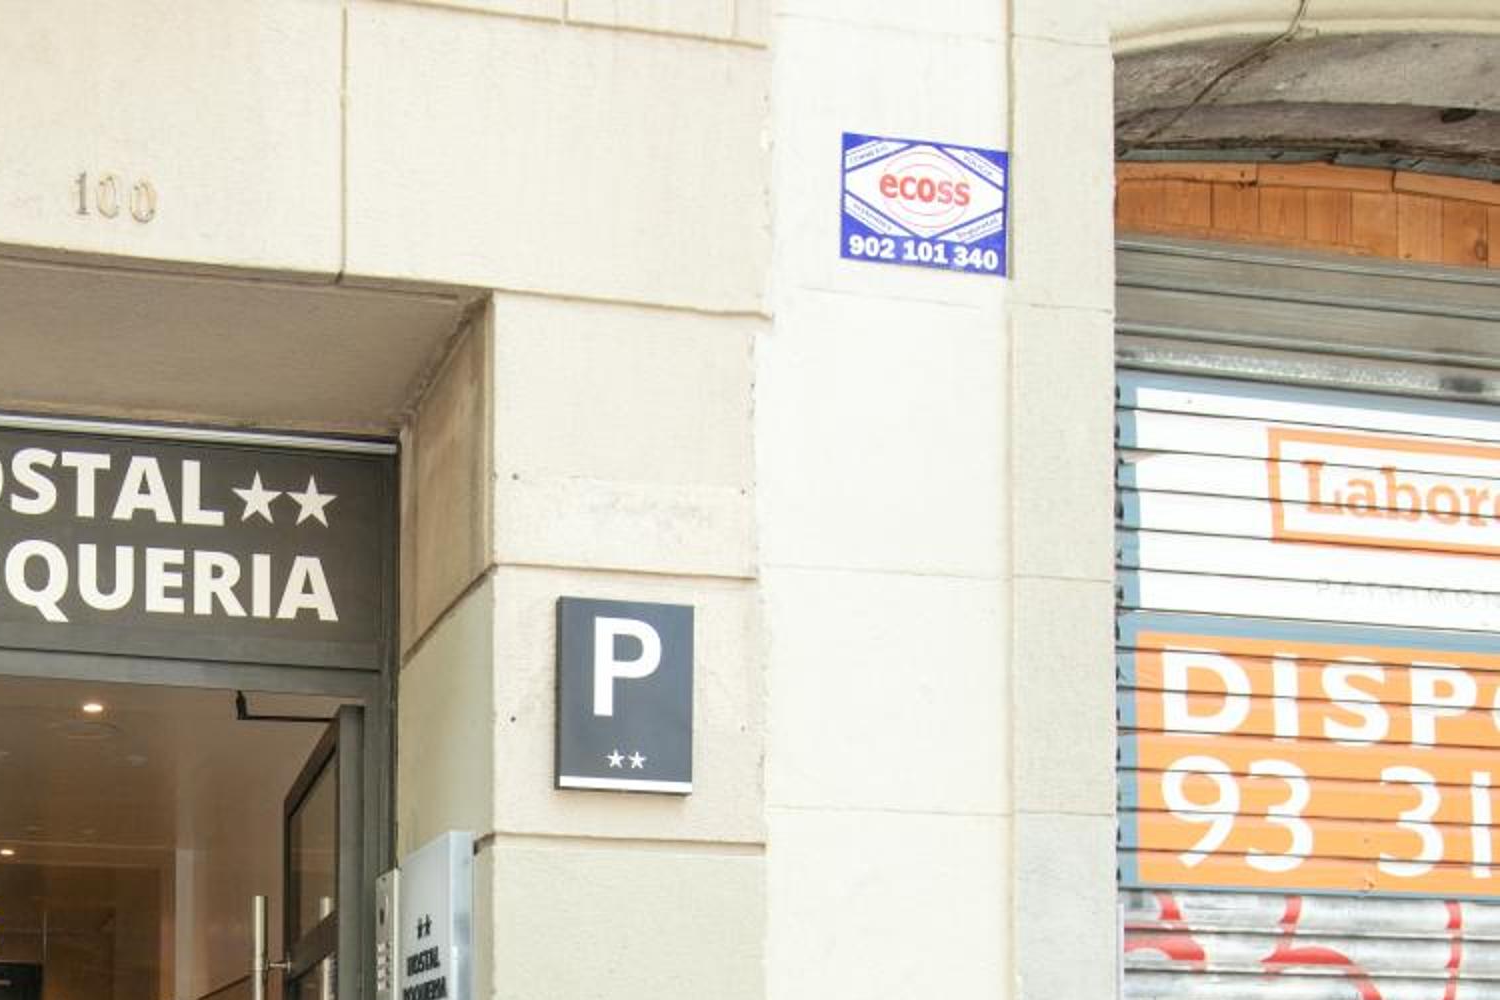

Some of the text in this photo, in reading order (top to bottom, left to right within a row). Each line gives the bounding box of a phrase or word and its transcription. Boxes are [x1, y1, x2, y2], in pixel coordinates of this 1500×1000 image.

[74, 170, 158, 224] 100
[878, 173, 971, 207] ecoss
[849, 235, 998, 270] 902 101 340
[1300, 457, 1500, 529] Labor
[593, 614, 662, 718] P
[1160, 645, 1500, 751] DISP
[1161, 755, 1314, 873] 93
